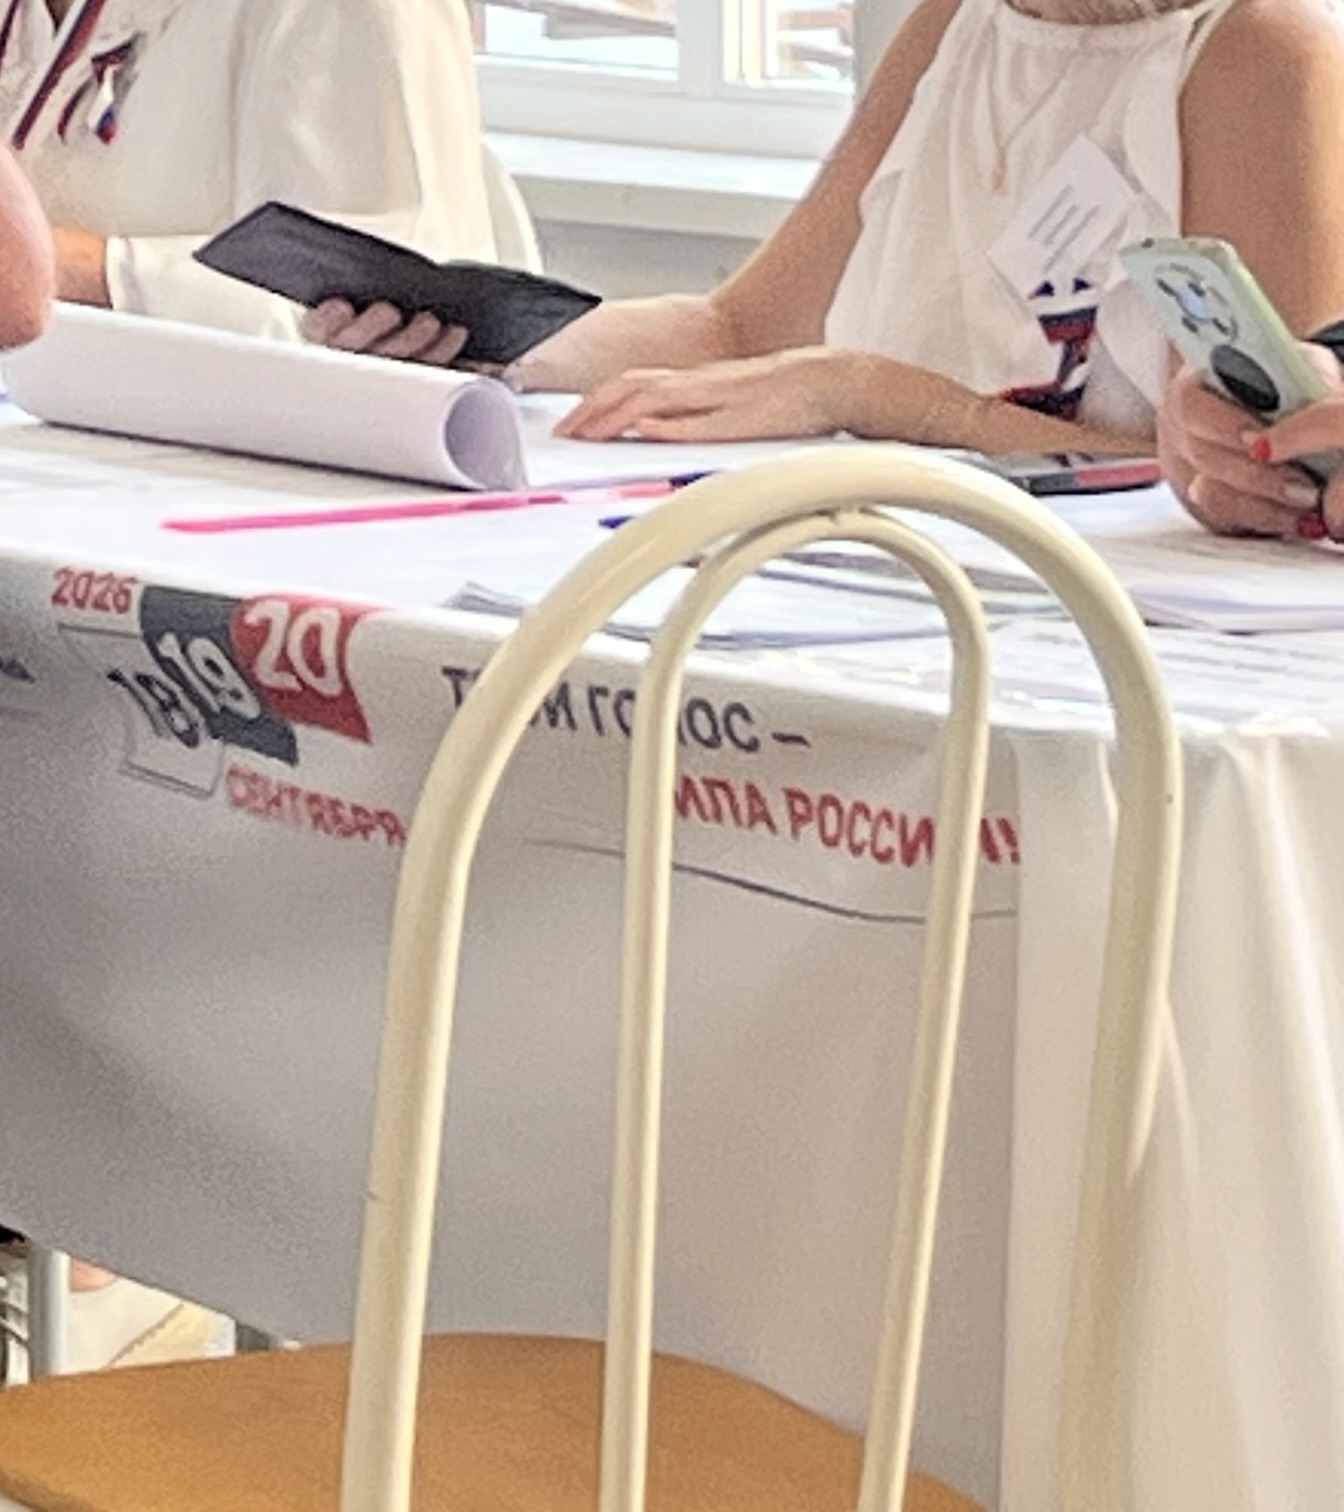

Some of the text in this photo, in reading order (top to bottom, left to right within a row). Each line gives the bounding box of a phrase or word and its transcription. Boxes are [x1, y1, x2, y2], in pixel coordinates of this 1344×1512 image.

[50, 566, 137, 615] 2026
[157, 631, 263, 719] 19
[242, 598, 343, 696] 20
[587, 685, 762, 753] ГООС
[674, 772, 778, 835] ИЛА
